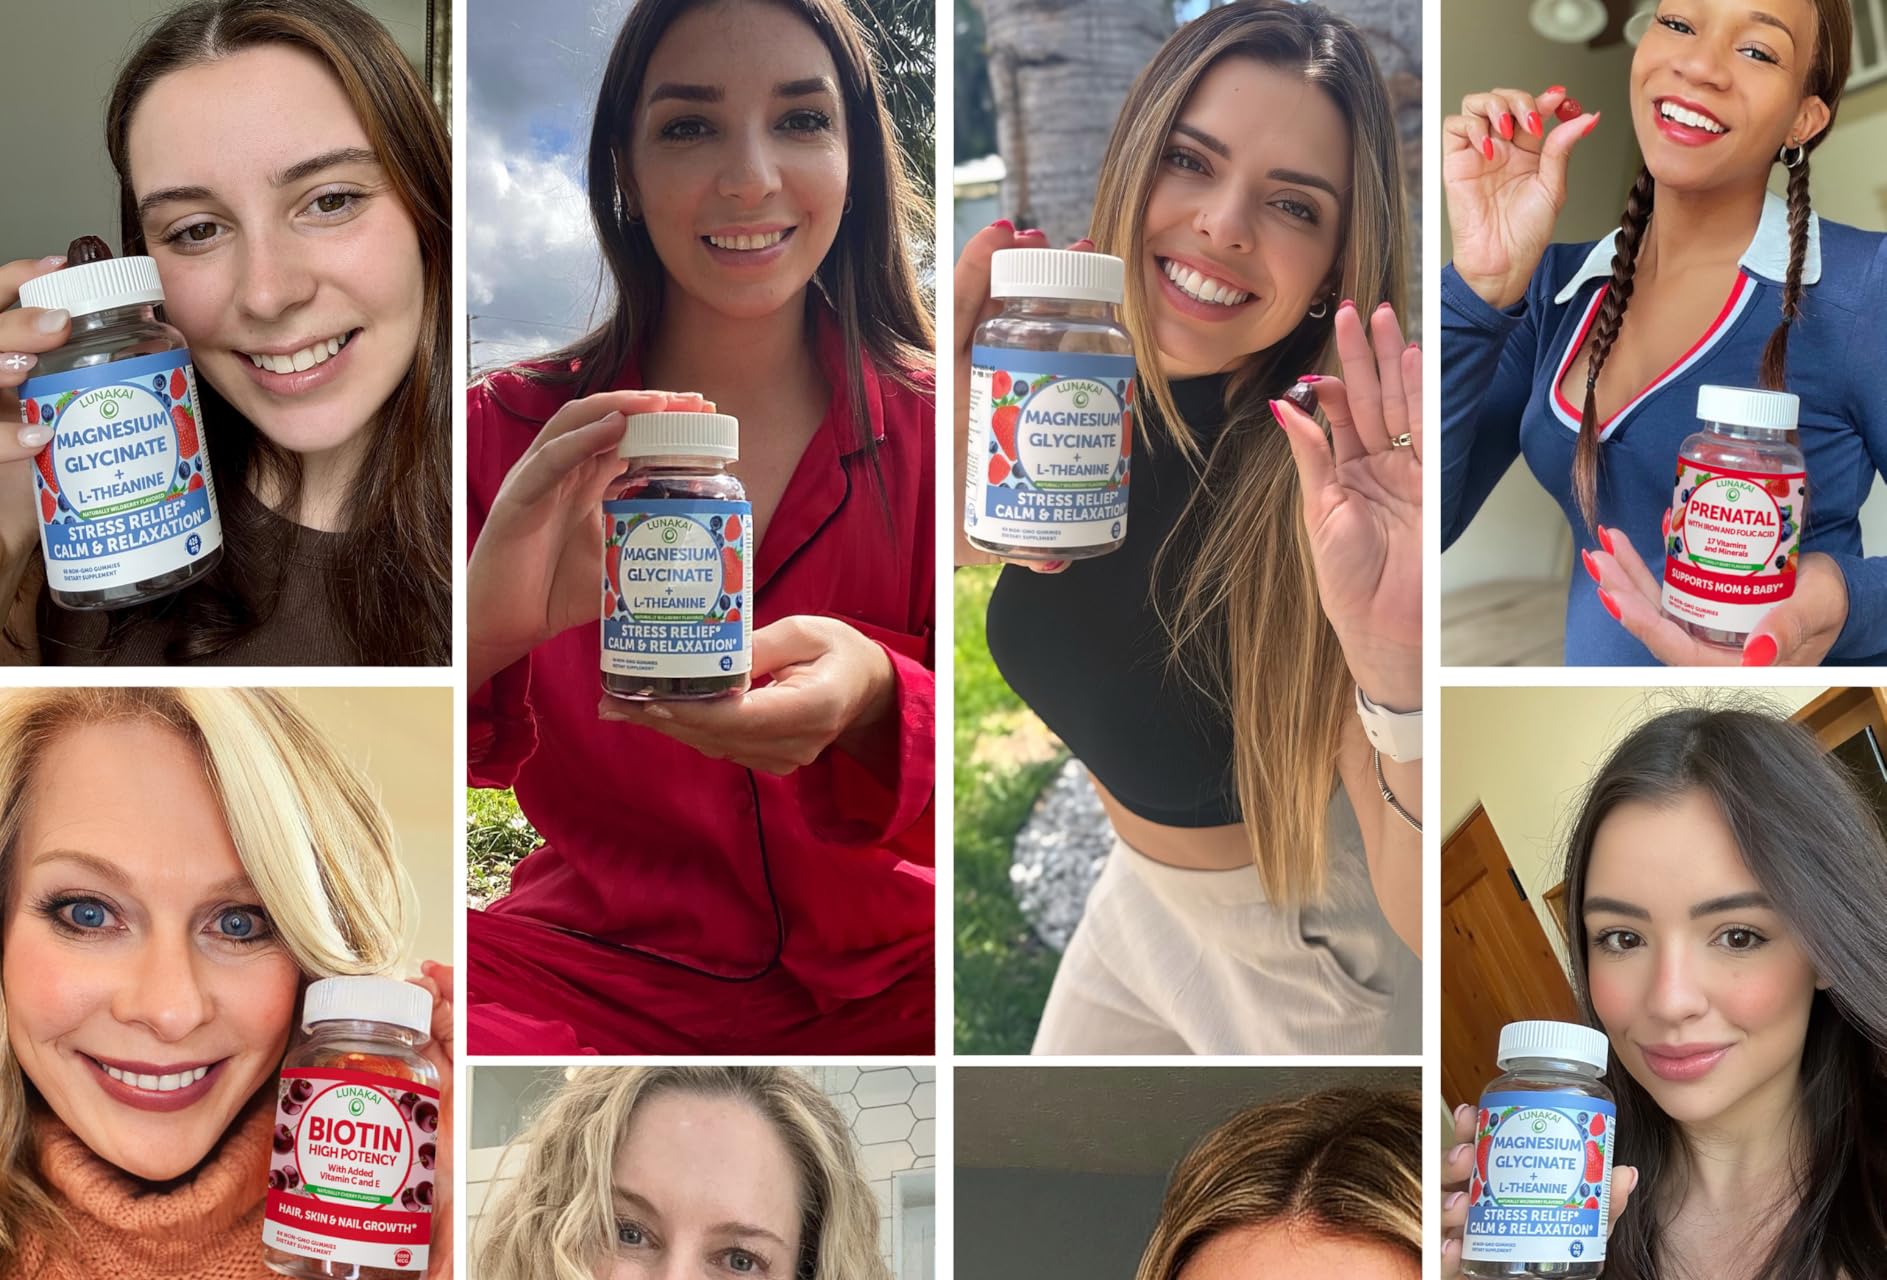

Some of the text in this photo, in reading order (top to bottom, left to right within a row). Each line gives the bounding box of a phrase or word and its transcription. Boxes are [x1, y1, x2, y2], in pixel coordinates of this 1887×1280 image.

[1057, 383, 1103, 395] LUNAKAI
[79, 388, 134, 408] LUNAKAI
[1026, 411, 1120, 426] MAGNESIUM
[57, 411, 168, 450] MAGNESIUM
[1030, 434, 1116, 448] GLYCINATE
[65, 436, 167, 473] GLYCINATE
[114, 469, 124, 480] +
[1037, 464, 1109, 476] L-THEANINE
[79, 472, 164, 504] L-THEANINE
[1716, 480, 1755, 493] LUNAKAI
[1018, 492, 1072, 506] STRESS
[995, 504, 1035, 520] CALM
[1039, 509, 1050, 520] &
[1690, 501, 1775, 526] PRENATAL
[69, 519, 125, 541] STRESS
[647, 518, 692, 531] LUNAKAI
[1688, 519, 1704, 528] WITH
[1704, 524, 1720, 532] IRON
[1720, 526, 1735, 535] AND
[1737, 528, 1756, 537] FOLIC
[55, 543, 89, 558] CALM
[93, 540, 103, 554] &
[1716, 539, 1747, 549] Vitamins
[624, 548, 717, 560] MAGNESIUM
[1719, 548, 1748, 557] Minerals
[94, 562, 120, 572] GUMMIES
[82, 570, 117, 581] SUPPLEMENT
[628, 568, 713, 582] GLYCINATE
[1672, 568, 1714, 590] SUPPORTS
[1715, 582, 1741, 594] MOM
[1744, 585, 1751, 594] &
[665, 587, 673, 595] +
[634, 597, 705, 608] L-THEANINE
[622, 625, 666, 638] STRESS
[608, 637, 634, 650] CALM
[638, 639, 646, 651] &
[336, 1088, 381, 1105] LUNAKAI
[1518, 1110, 1562, 1123] LUNAKAI
[309, 1116, 402, 1152] BIOTIN
[1494, 1136, 1581, 1152] MAGNESIUM
[309, 1144, 397, 1167] HIGH POTENCY
[1496, 1156, 1576, 1170] GLYCINATE
[328, 1164, 373, 1177] With Added
[320, 1171, 349, 1183] Vitamin
[376, 1180, 380, 1188] E
[1499, 1182, 1567, 1194] L-THEANINE
[279, 1203, 303, 1220] HAIR,
[305, 1210, 328, 1224] SKIN
[329, 1216, 337, 1225] &
[338, 1217, 361, 1229] NAIL
[1484, 1209, 1527, 1221] STRESS
[1471, 1222, 1495, 1233] CALM
[1498, 1223, 1507, 1234] &
[298, 1242, 332, 1255] SUPPLEMENT
[311, 1239, 336, 1250] GUMMIES
